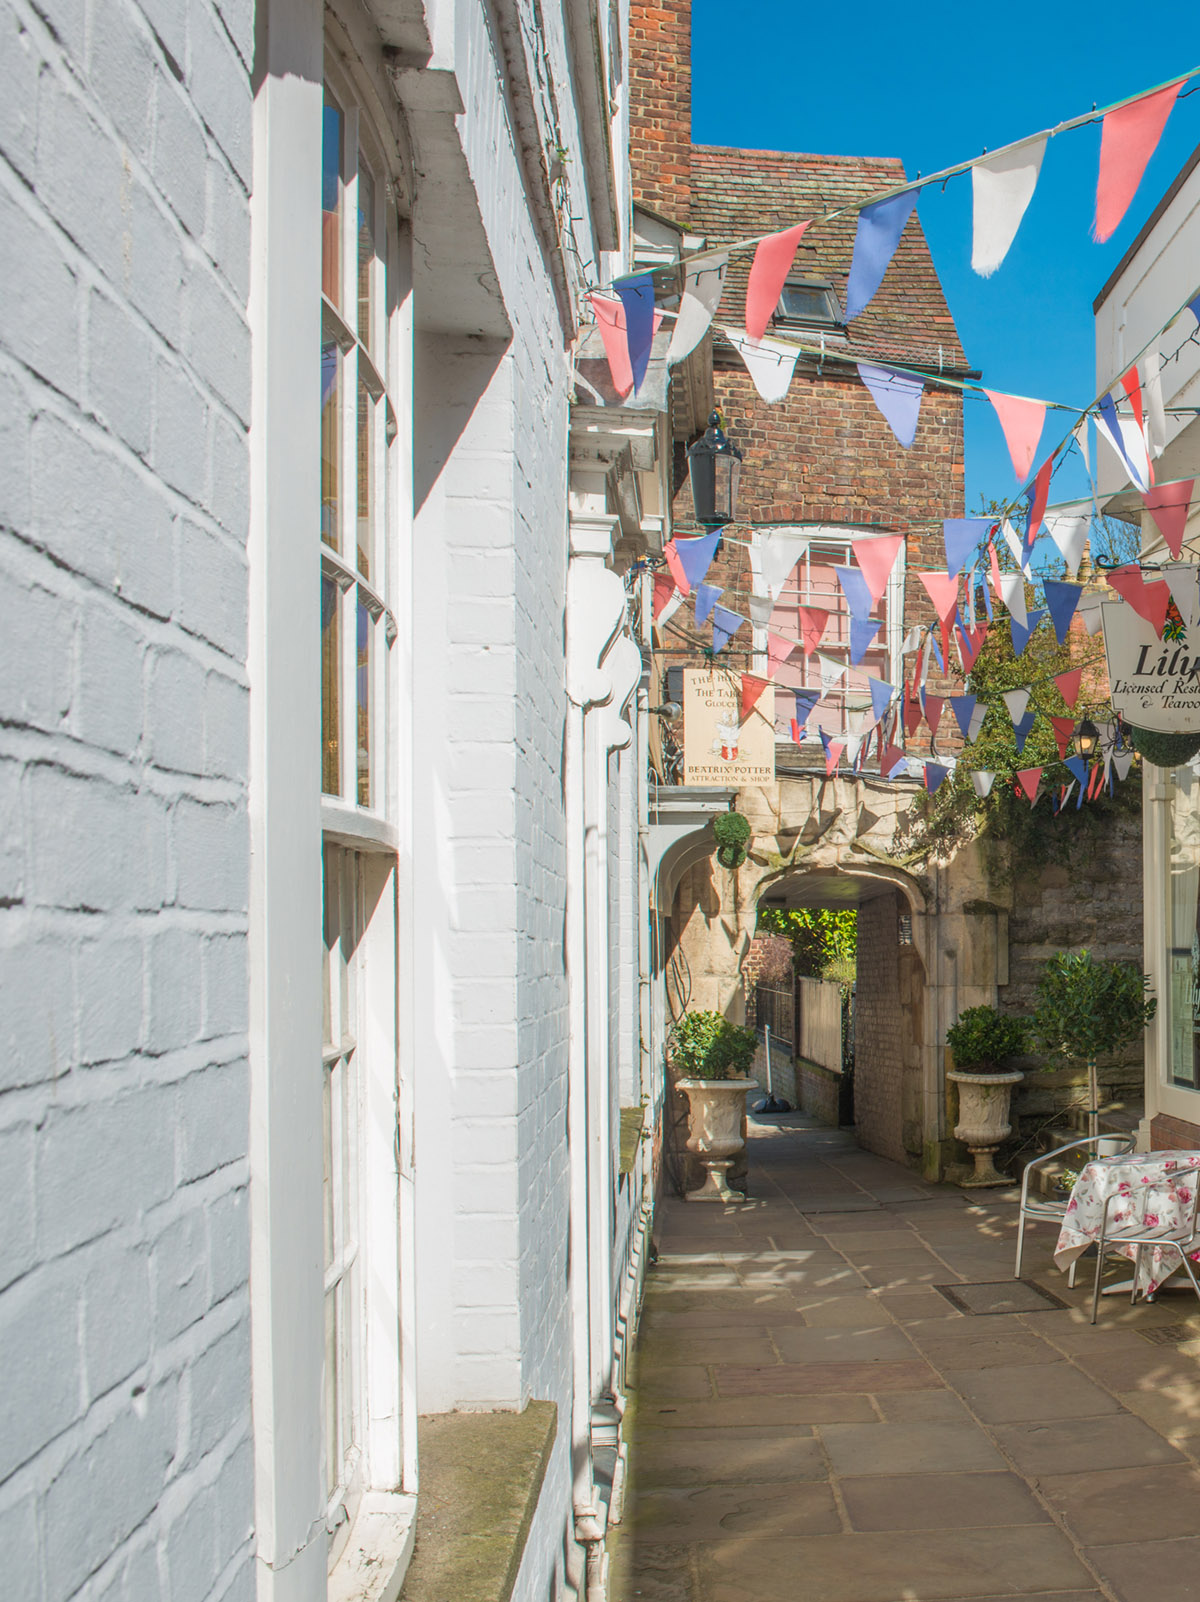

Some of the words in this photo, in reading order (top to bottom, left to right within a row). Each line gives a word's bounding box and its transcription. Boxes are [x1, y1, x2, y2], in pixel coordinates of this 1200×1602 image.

[1132, 643, 1200, 684] Lily
[691, 675, 713, 685] THE
[1112, 679, 1168, 695] Licensed
[695, 688, 714, 697] THE
[717, 688, 743, 698] TAILO
[704, 699, 744, 708] GLOUCES
[1140, 695, 1154, 709] &
[734, 766, 772, 775] POTTER
